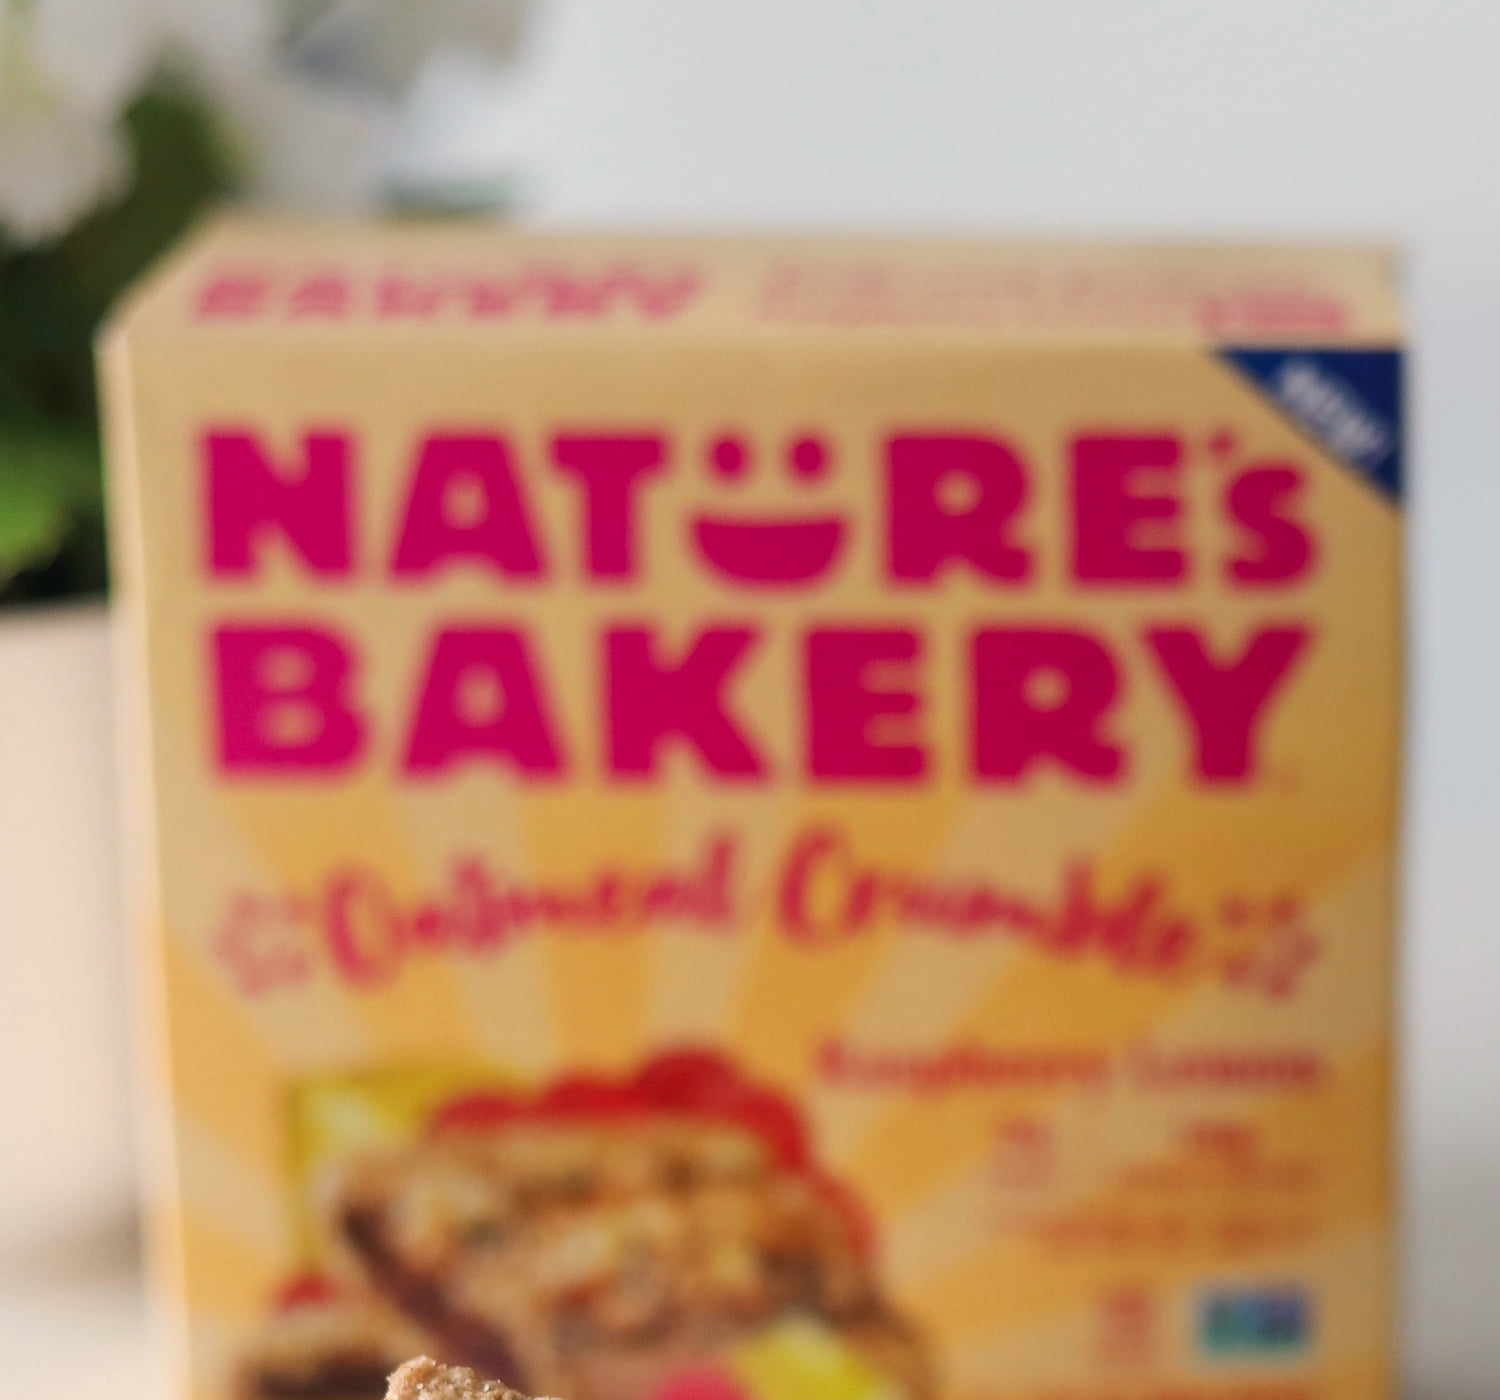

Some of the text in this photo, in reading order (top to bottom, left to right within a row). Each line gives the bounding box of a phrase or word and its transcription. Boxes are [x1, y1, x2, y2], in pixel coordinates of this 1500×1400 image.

[208, 622, 1314, 788] BAKERY
[322, 824, 1196, 990] Oatmeal Crumble
